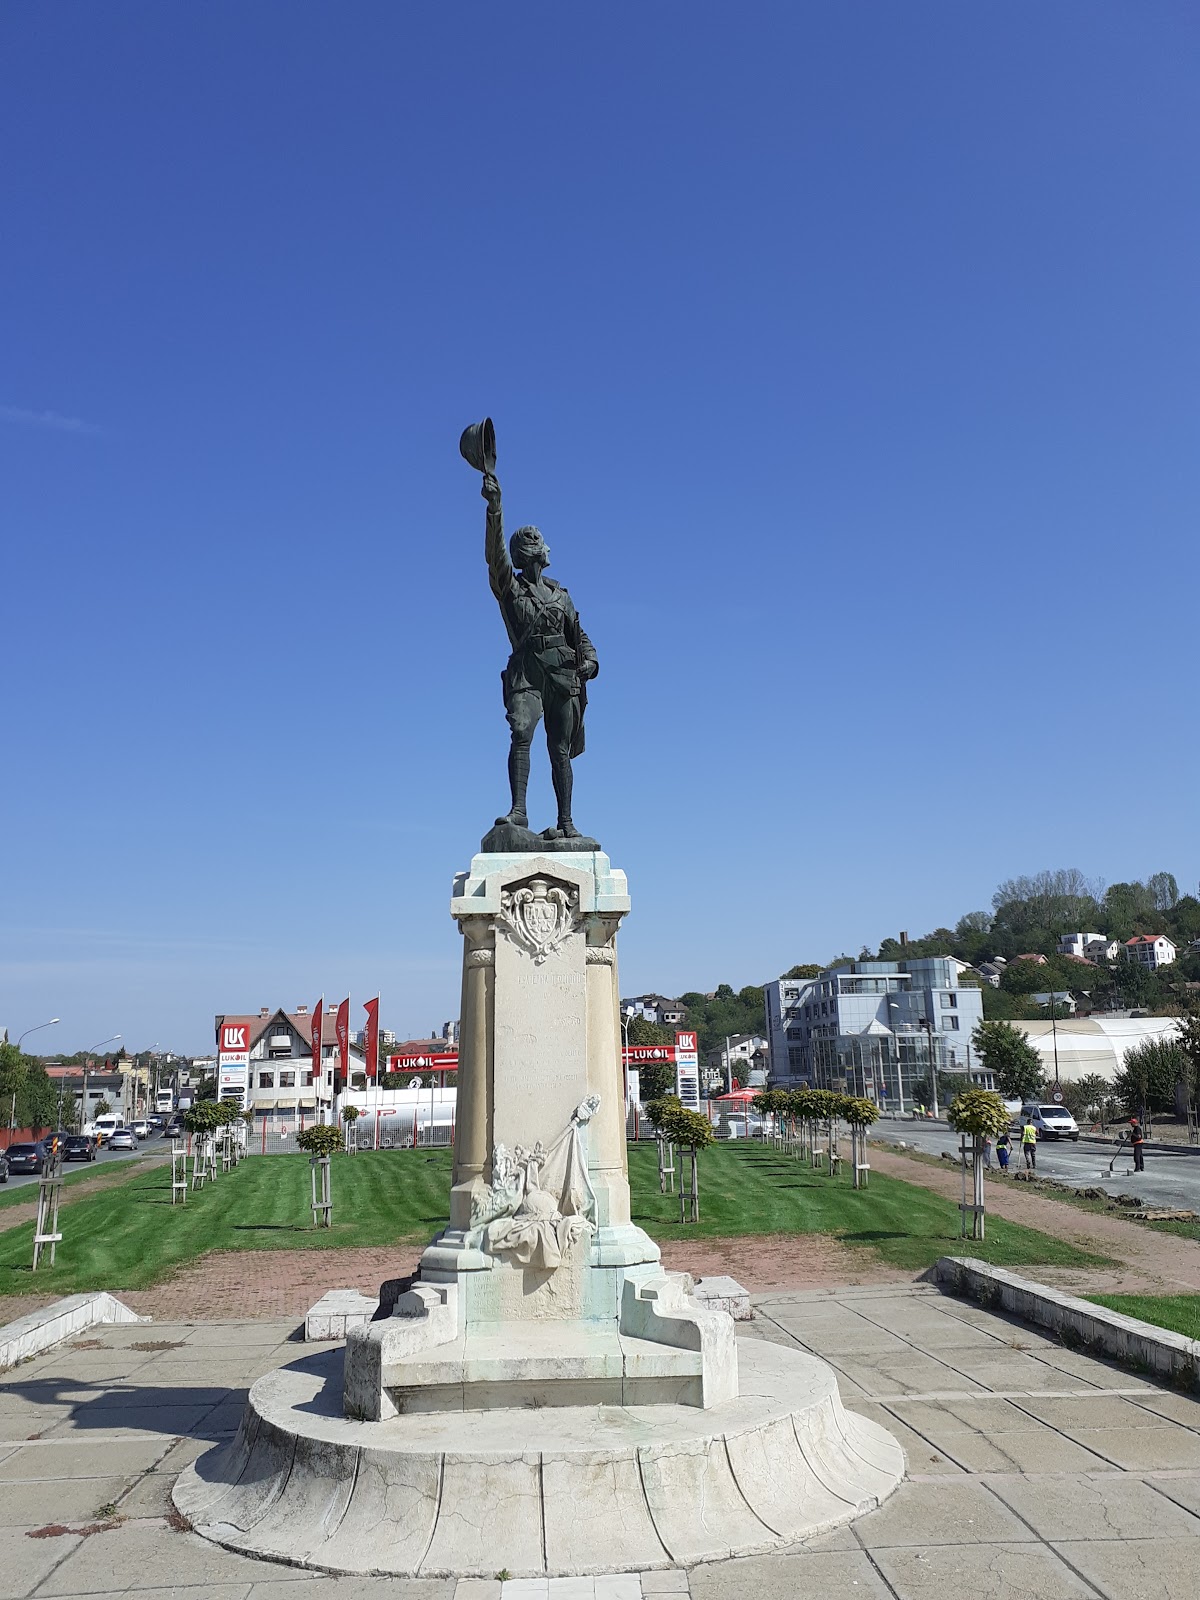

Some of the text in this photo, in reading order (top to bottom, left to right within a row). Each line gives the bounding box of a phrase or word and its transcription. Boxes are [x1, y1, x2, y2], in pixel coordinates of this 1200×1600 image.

[224, 1027, 246, 1049] LUK
[679, 1034, 695, 1050] LUK
[221, 1054, 247, 1062] LUKOIL
[634, 1048, 670, 1059] LUKOIL
[397, 1056, 434, 1068] LUKOIL
[701, 1070, 723, 1080] HOTEL
